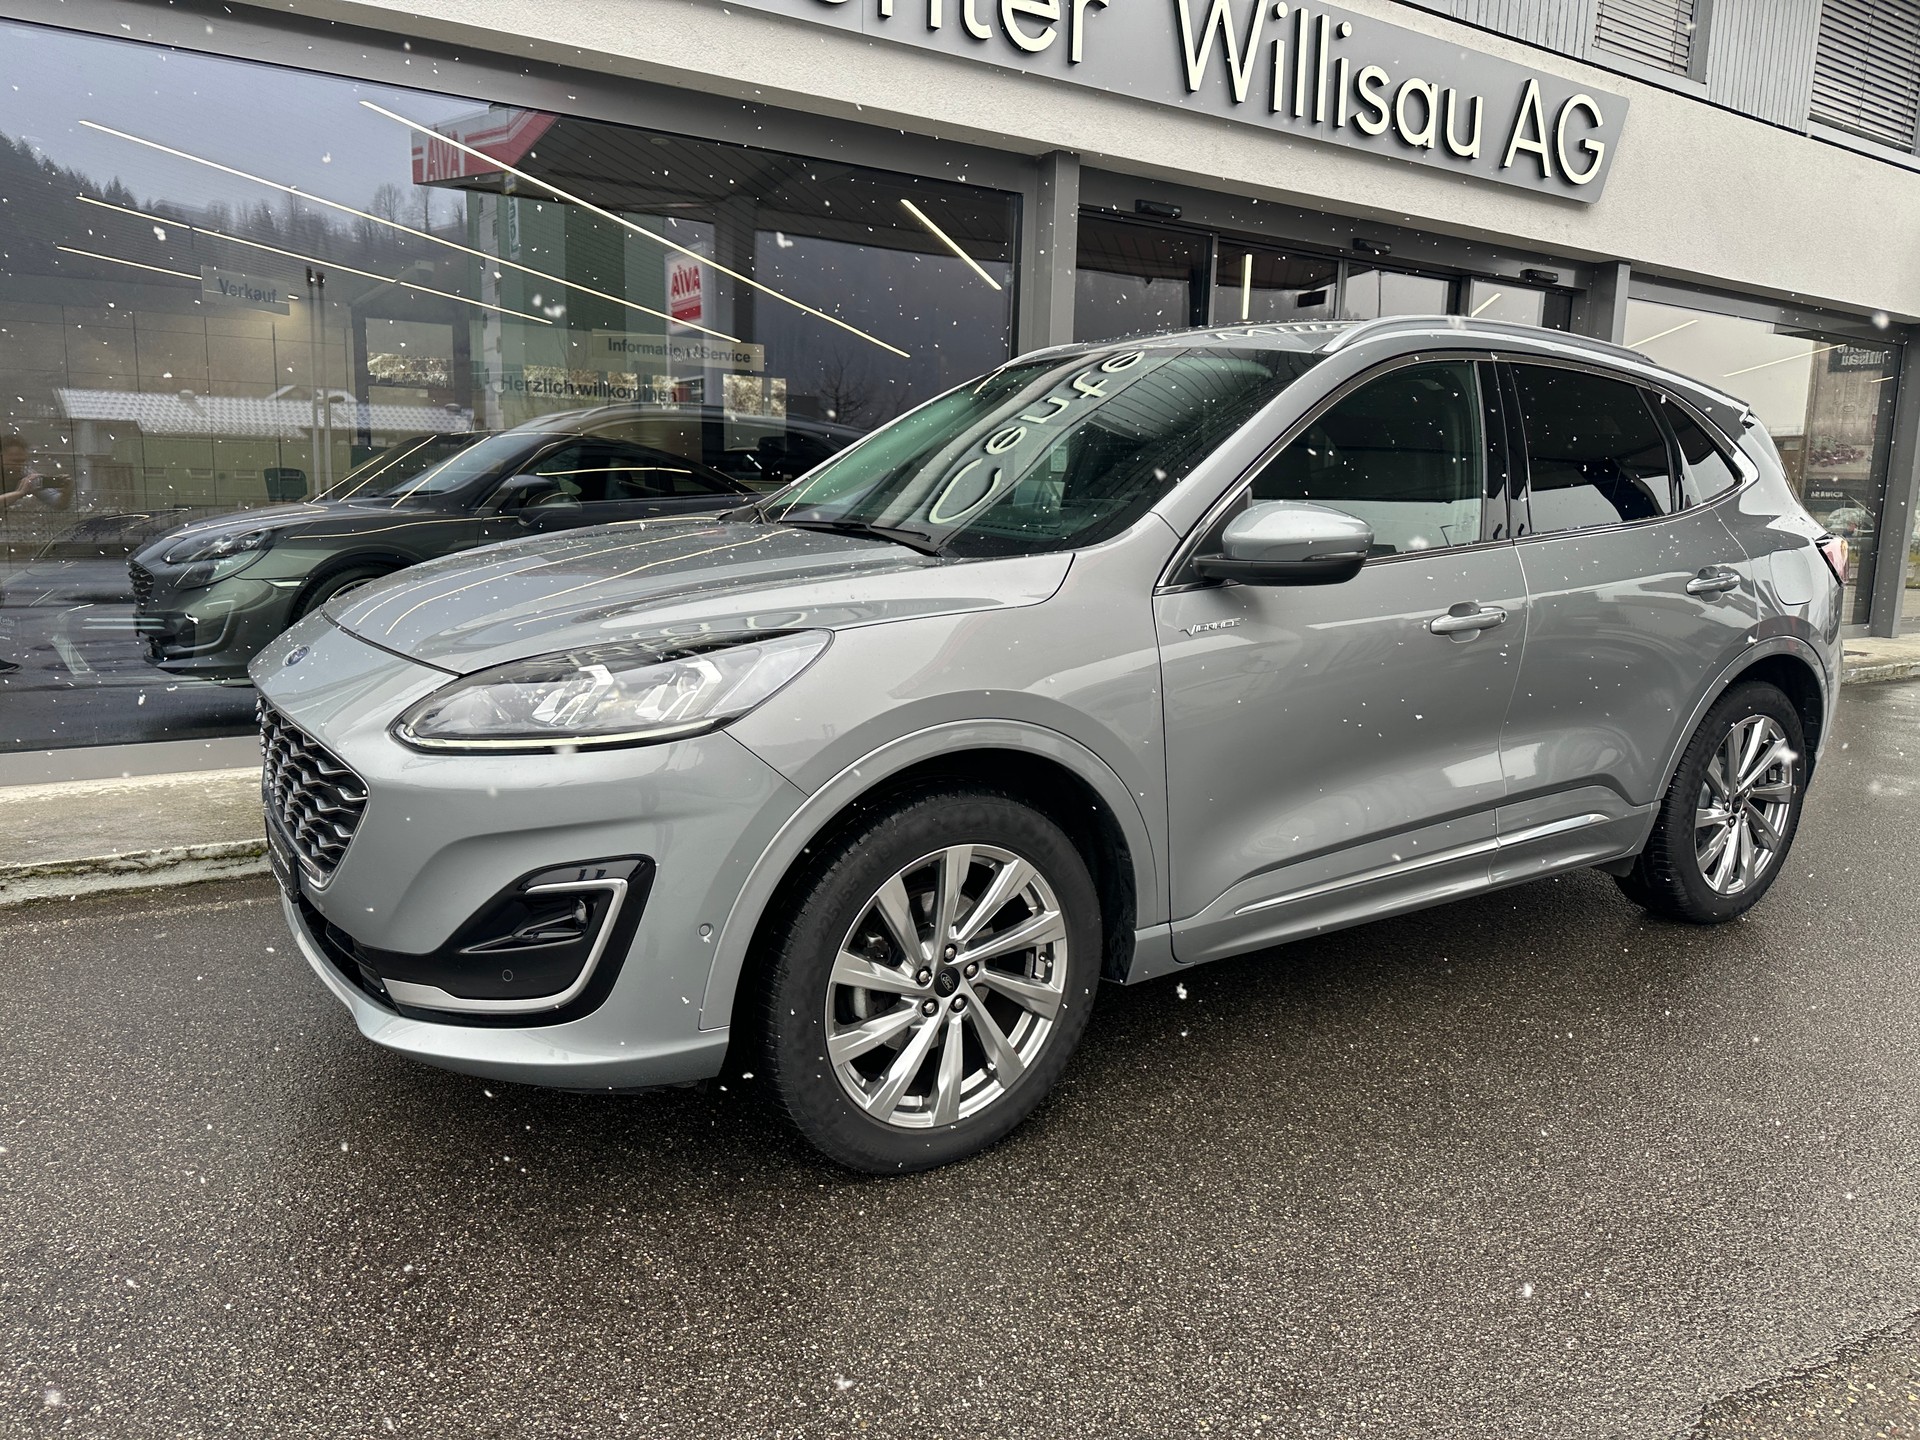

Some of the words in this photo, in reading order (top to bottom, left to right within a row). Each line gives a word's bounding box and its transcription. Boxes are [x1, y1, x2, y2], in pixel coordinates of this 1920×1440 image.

[1175, 0, 1484, 159] Willisau
[1501, 78, 1606, 186] AG
[218, 279, 277, 303] Verkauf
[701, 346, 751, 363] Service
[502, 374, 574, 395] Herzlich
[578, 381, 677, 402] willkommen
